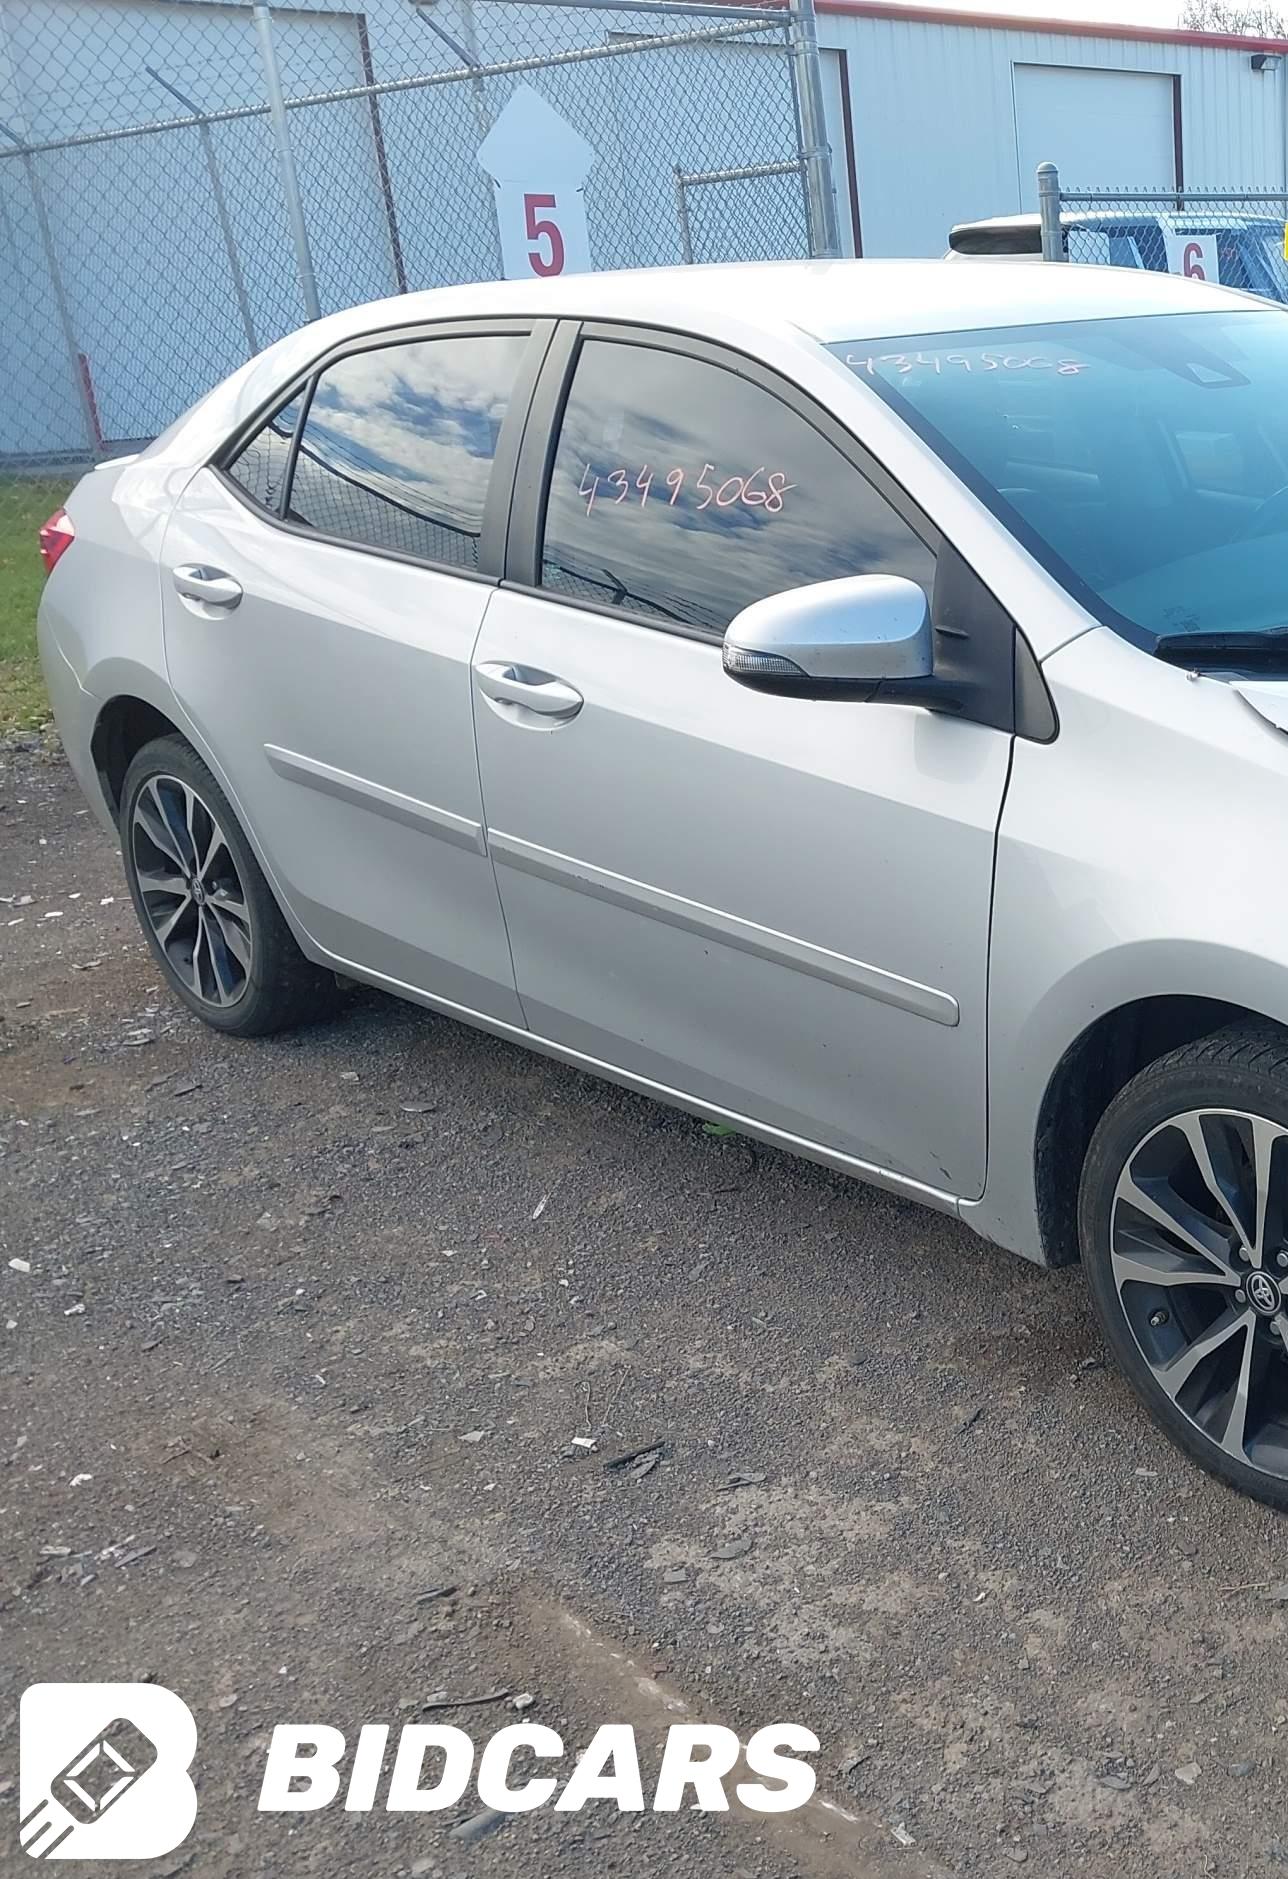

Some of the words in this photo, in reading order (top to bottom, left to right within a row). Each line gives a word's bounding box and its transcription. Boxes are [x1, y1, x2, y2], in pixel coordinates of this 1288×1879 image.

[523, 193, 565, 278] 5
[1183, 242, 1206, 281] 6
[578, 463, 798, 517] 43495068
